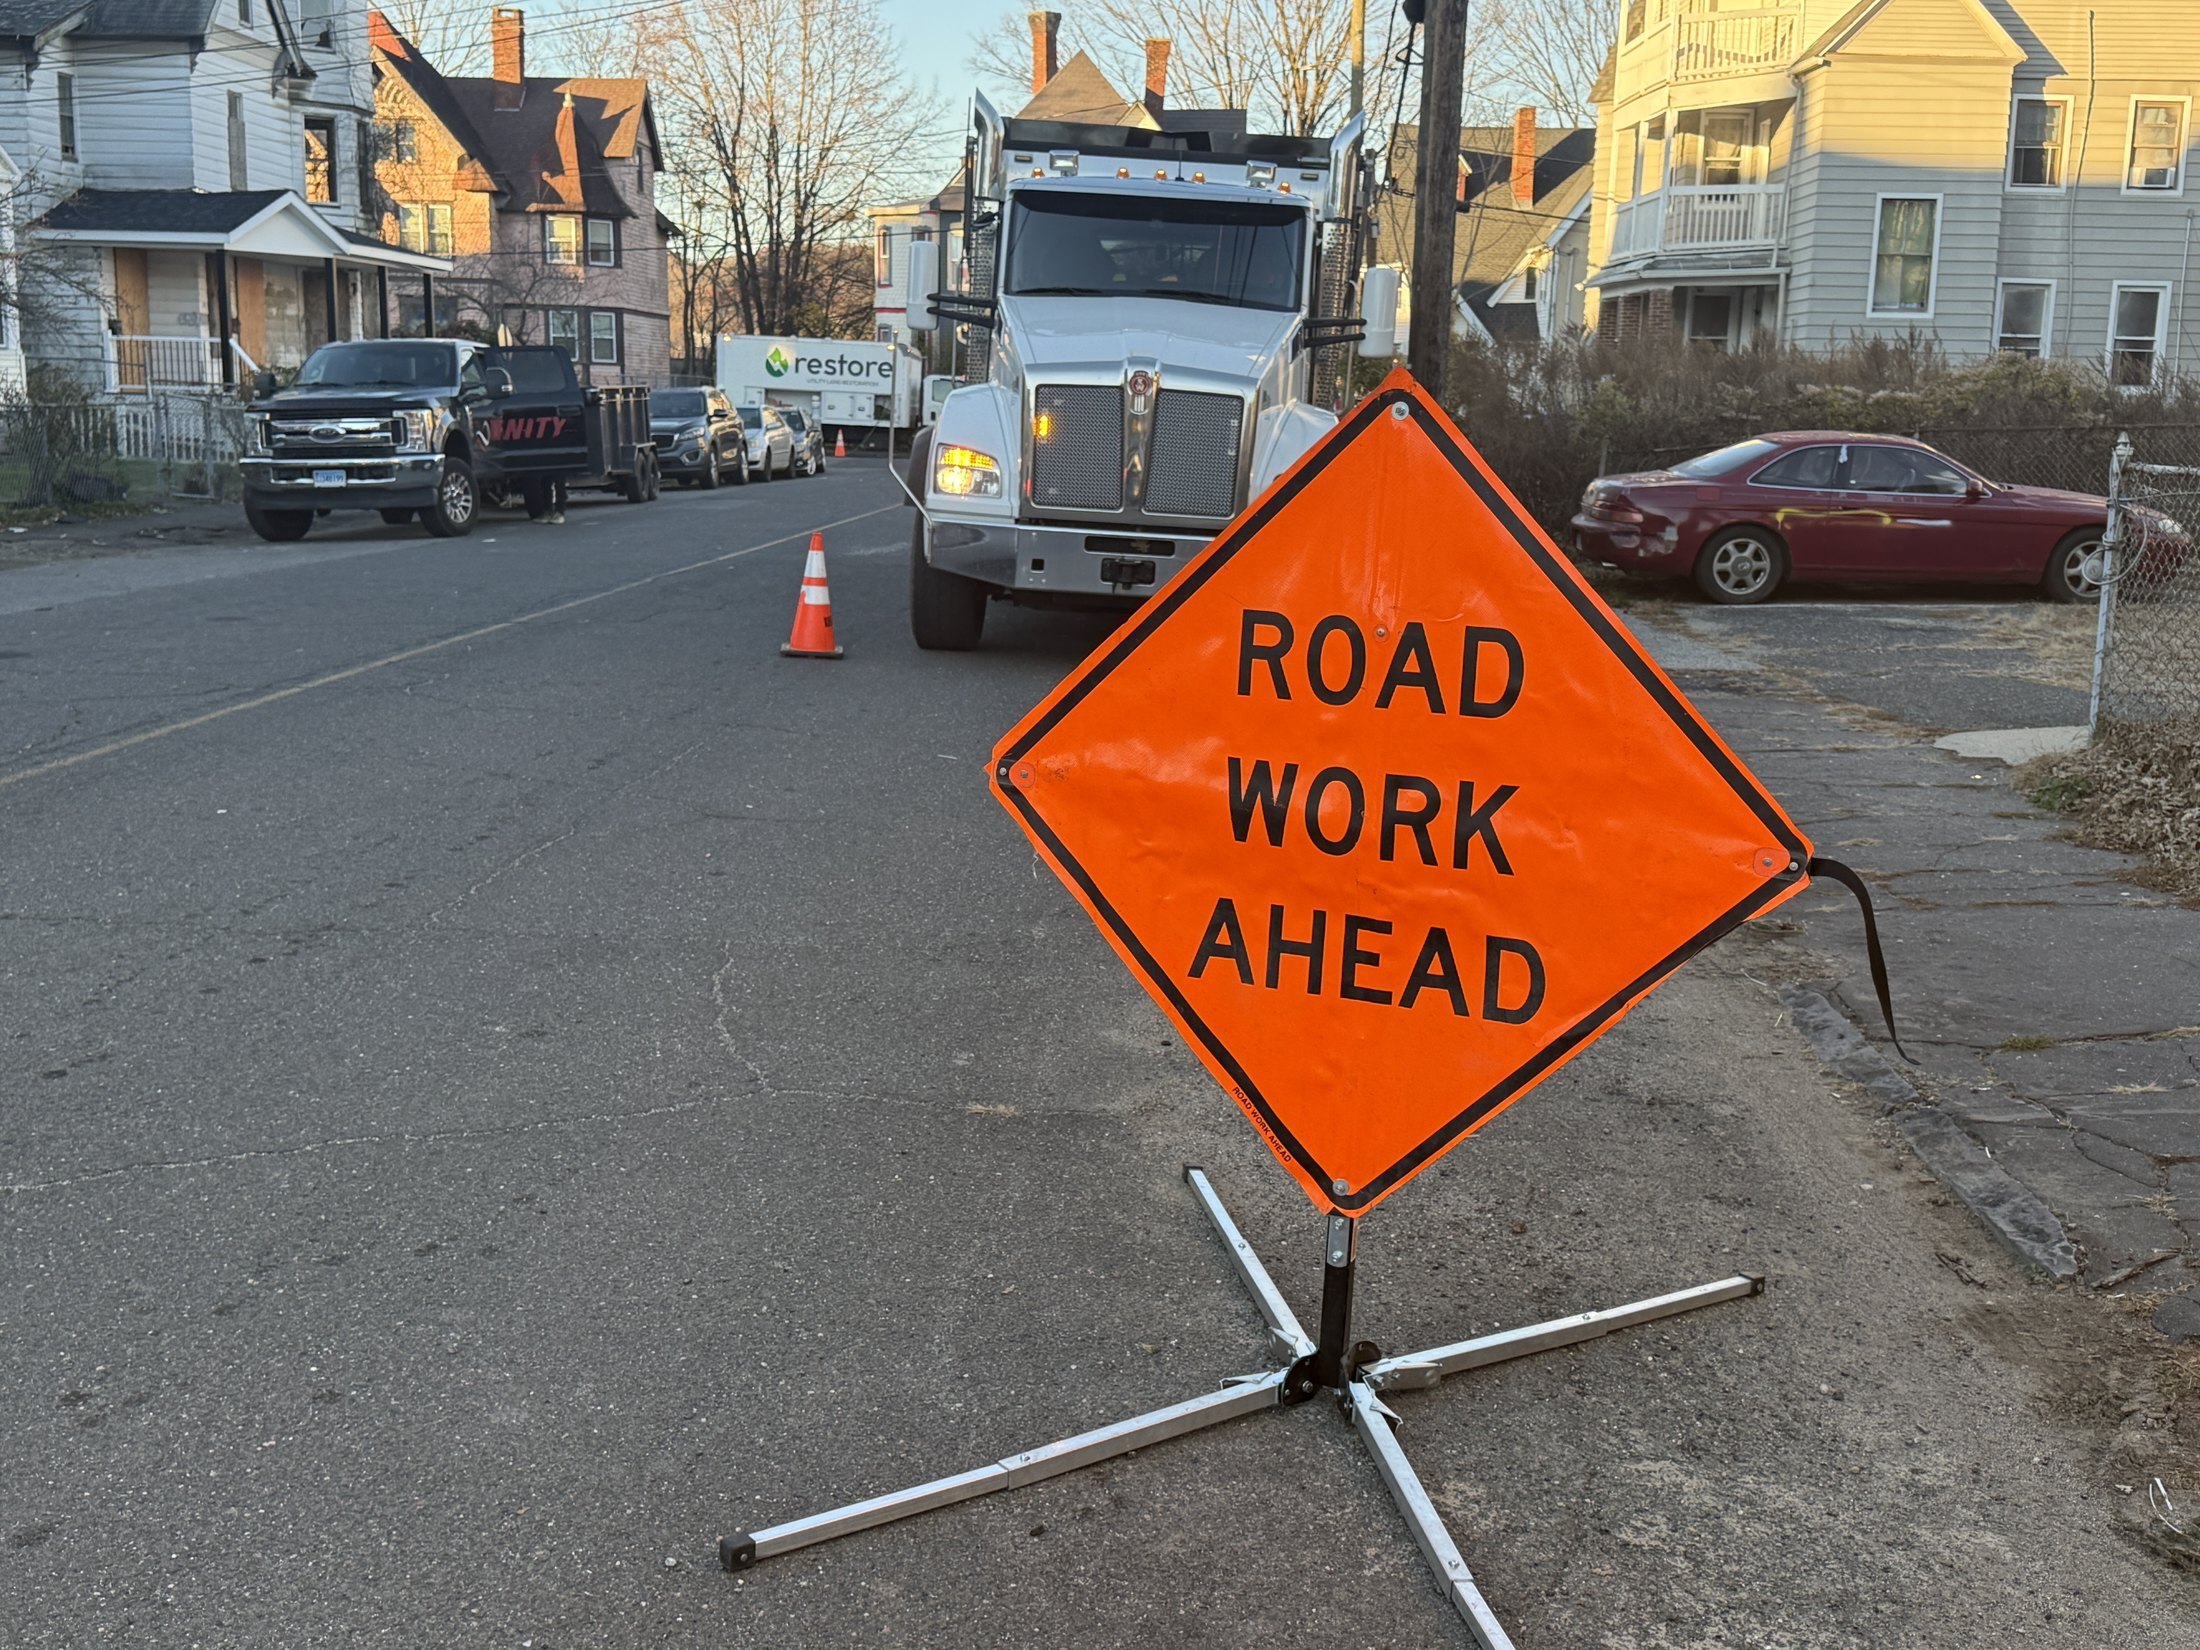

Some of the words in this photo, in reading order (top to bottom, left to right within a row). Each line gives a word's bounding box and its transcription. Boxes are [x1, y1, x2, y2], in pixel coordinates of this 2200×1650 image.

[795, 354, 893, 378] restore
[1237, 608, 1525, 719] ROAD
[1227, 756, 1520, 876] WORK
[1187, 897, 1546, 1025] AHEAD
[1232, 1086, 1253, 1110] ROAD
[1250, 1109, 1271, 1136] WORK
[1268, 1135, 1292, 1163] AHEAD
